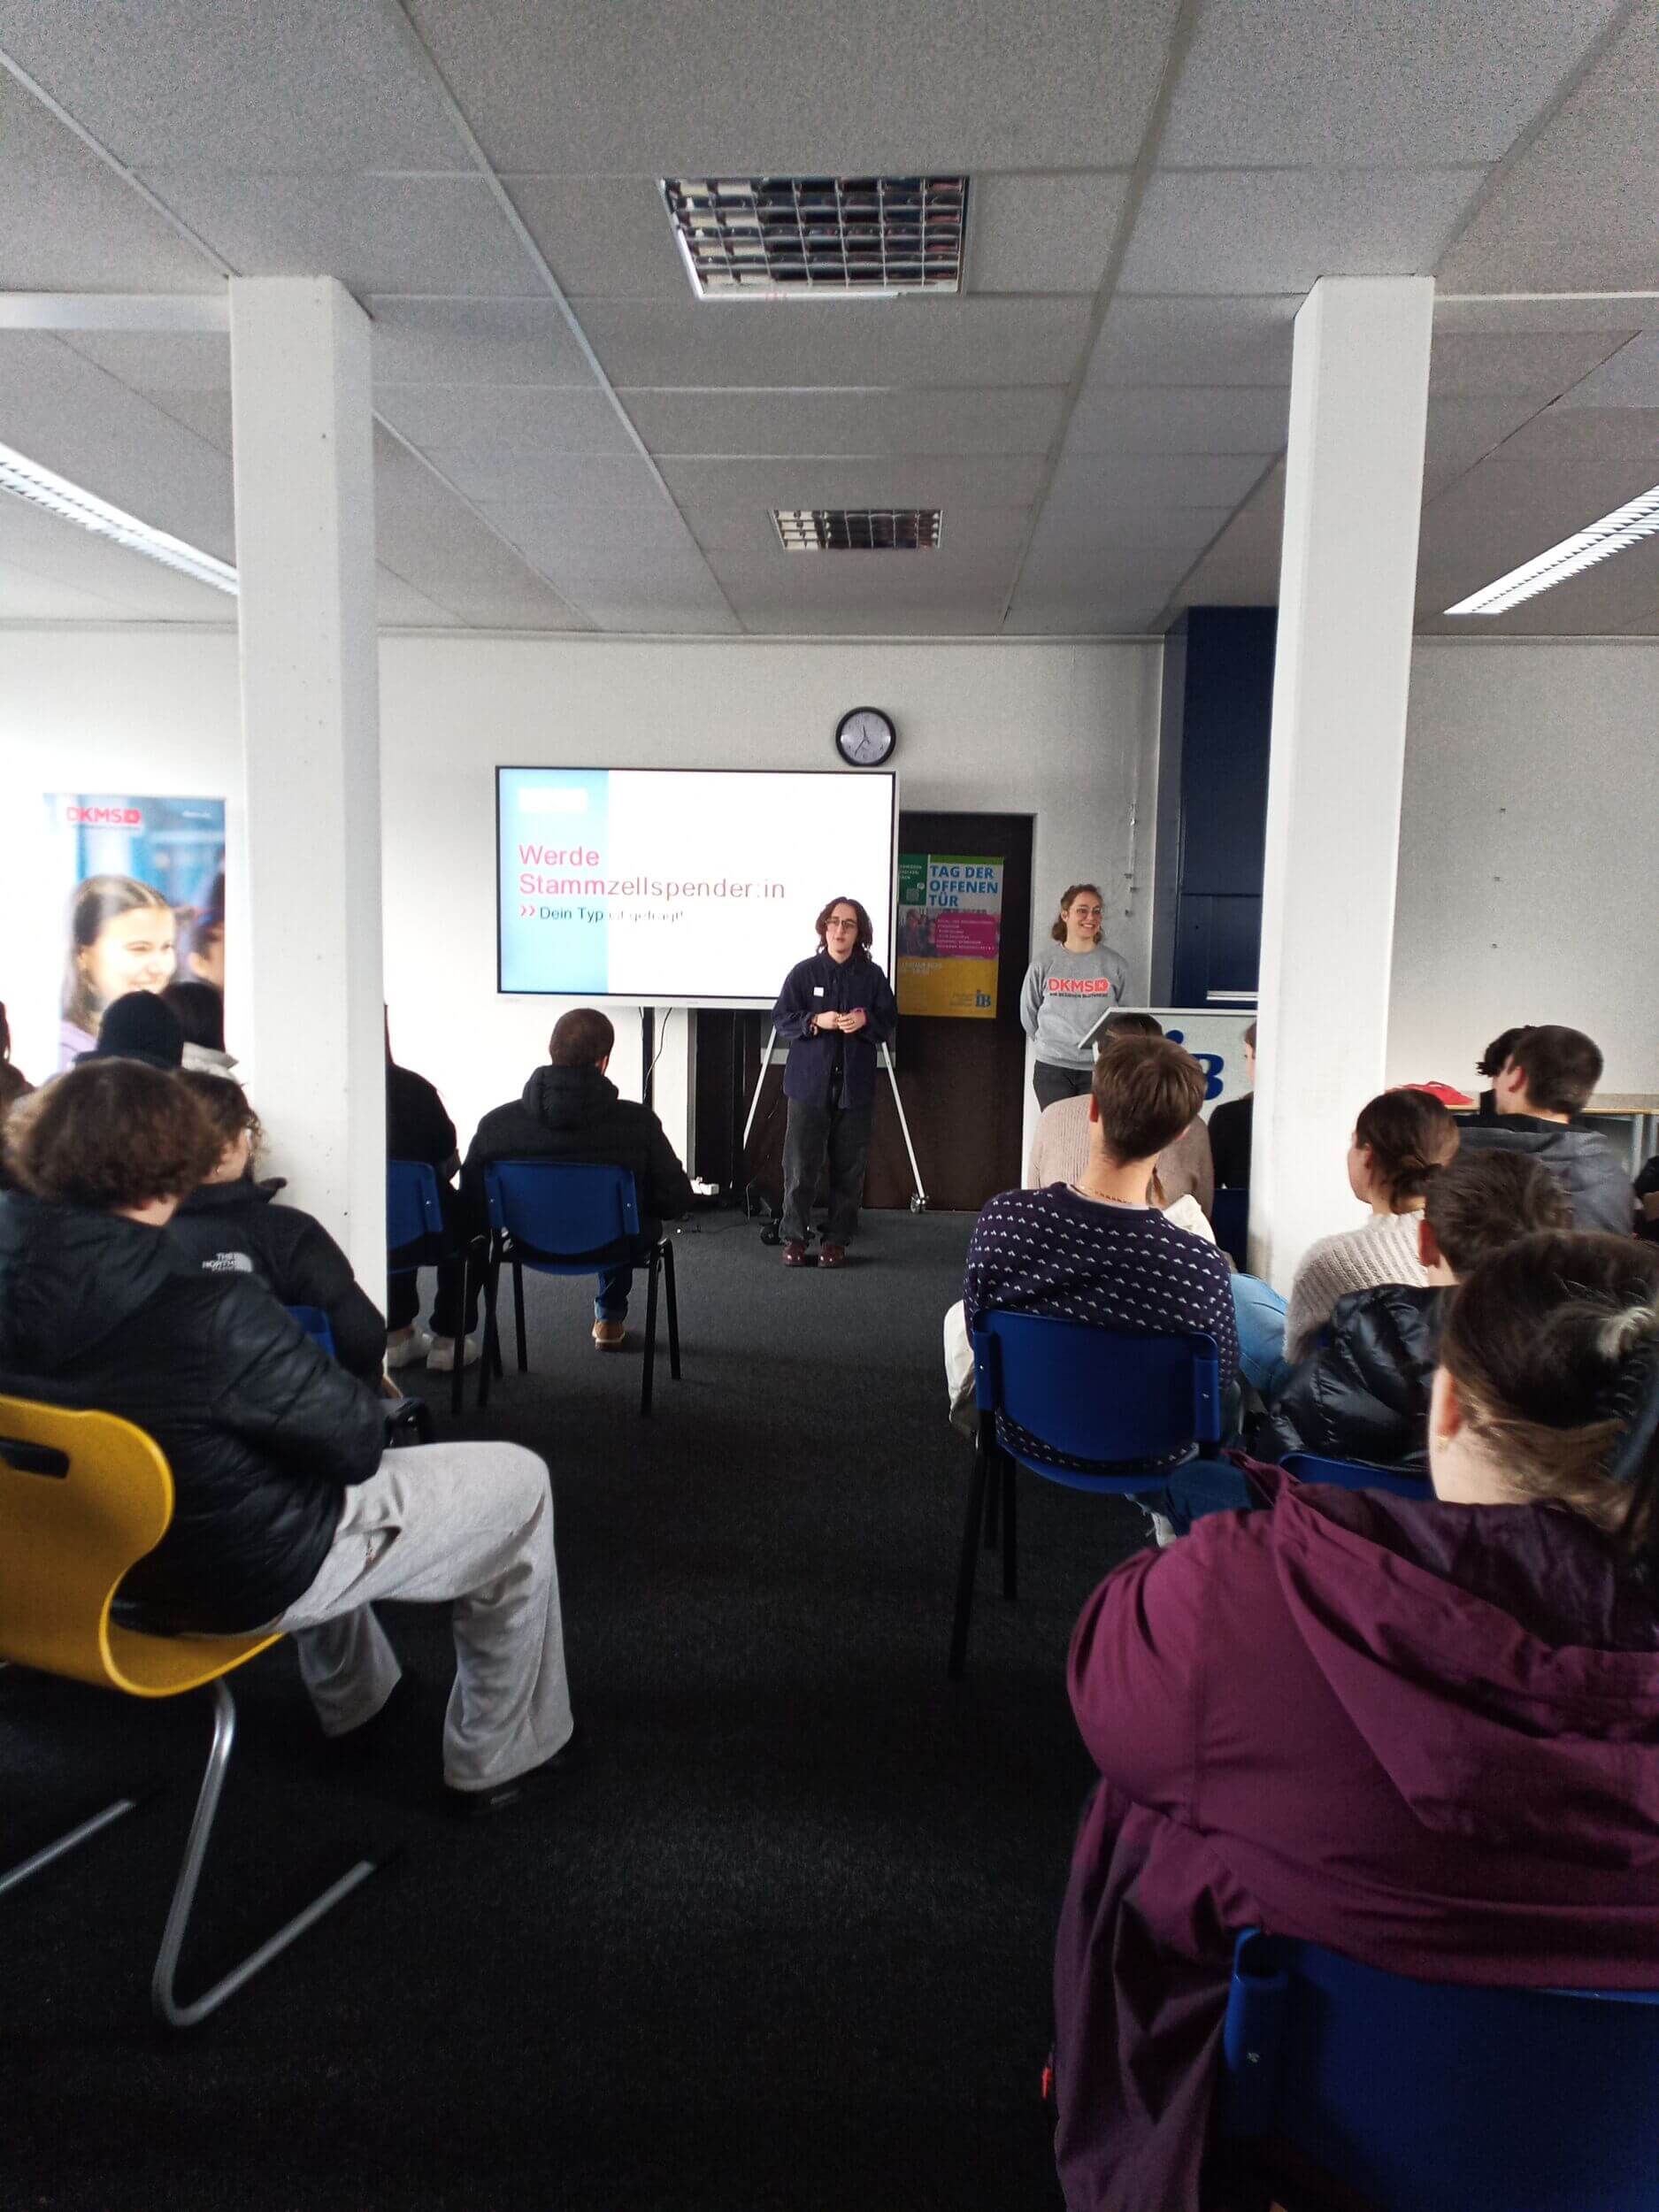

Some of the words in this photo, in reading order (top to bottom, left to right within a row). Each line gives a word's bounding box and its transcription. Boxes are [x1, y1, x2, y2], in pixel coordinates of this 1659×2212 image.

[66, 806, 122, 823] DKMS
[518, 844, 600, 866] Werde
[930, 864, 960, 879] TAG
[964, 866, 995, 879] DER
[519, 872, 785, 902] Stammzellspender:in
[929, 879, 999, 895] OFFENEN
[929, 891, 958, 908] TÜR
[539, 906, 572, 920] Dein
[577, 907, 604, 924] Typ
[1048, 978, 1094, 992] DKMS
